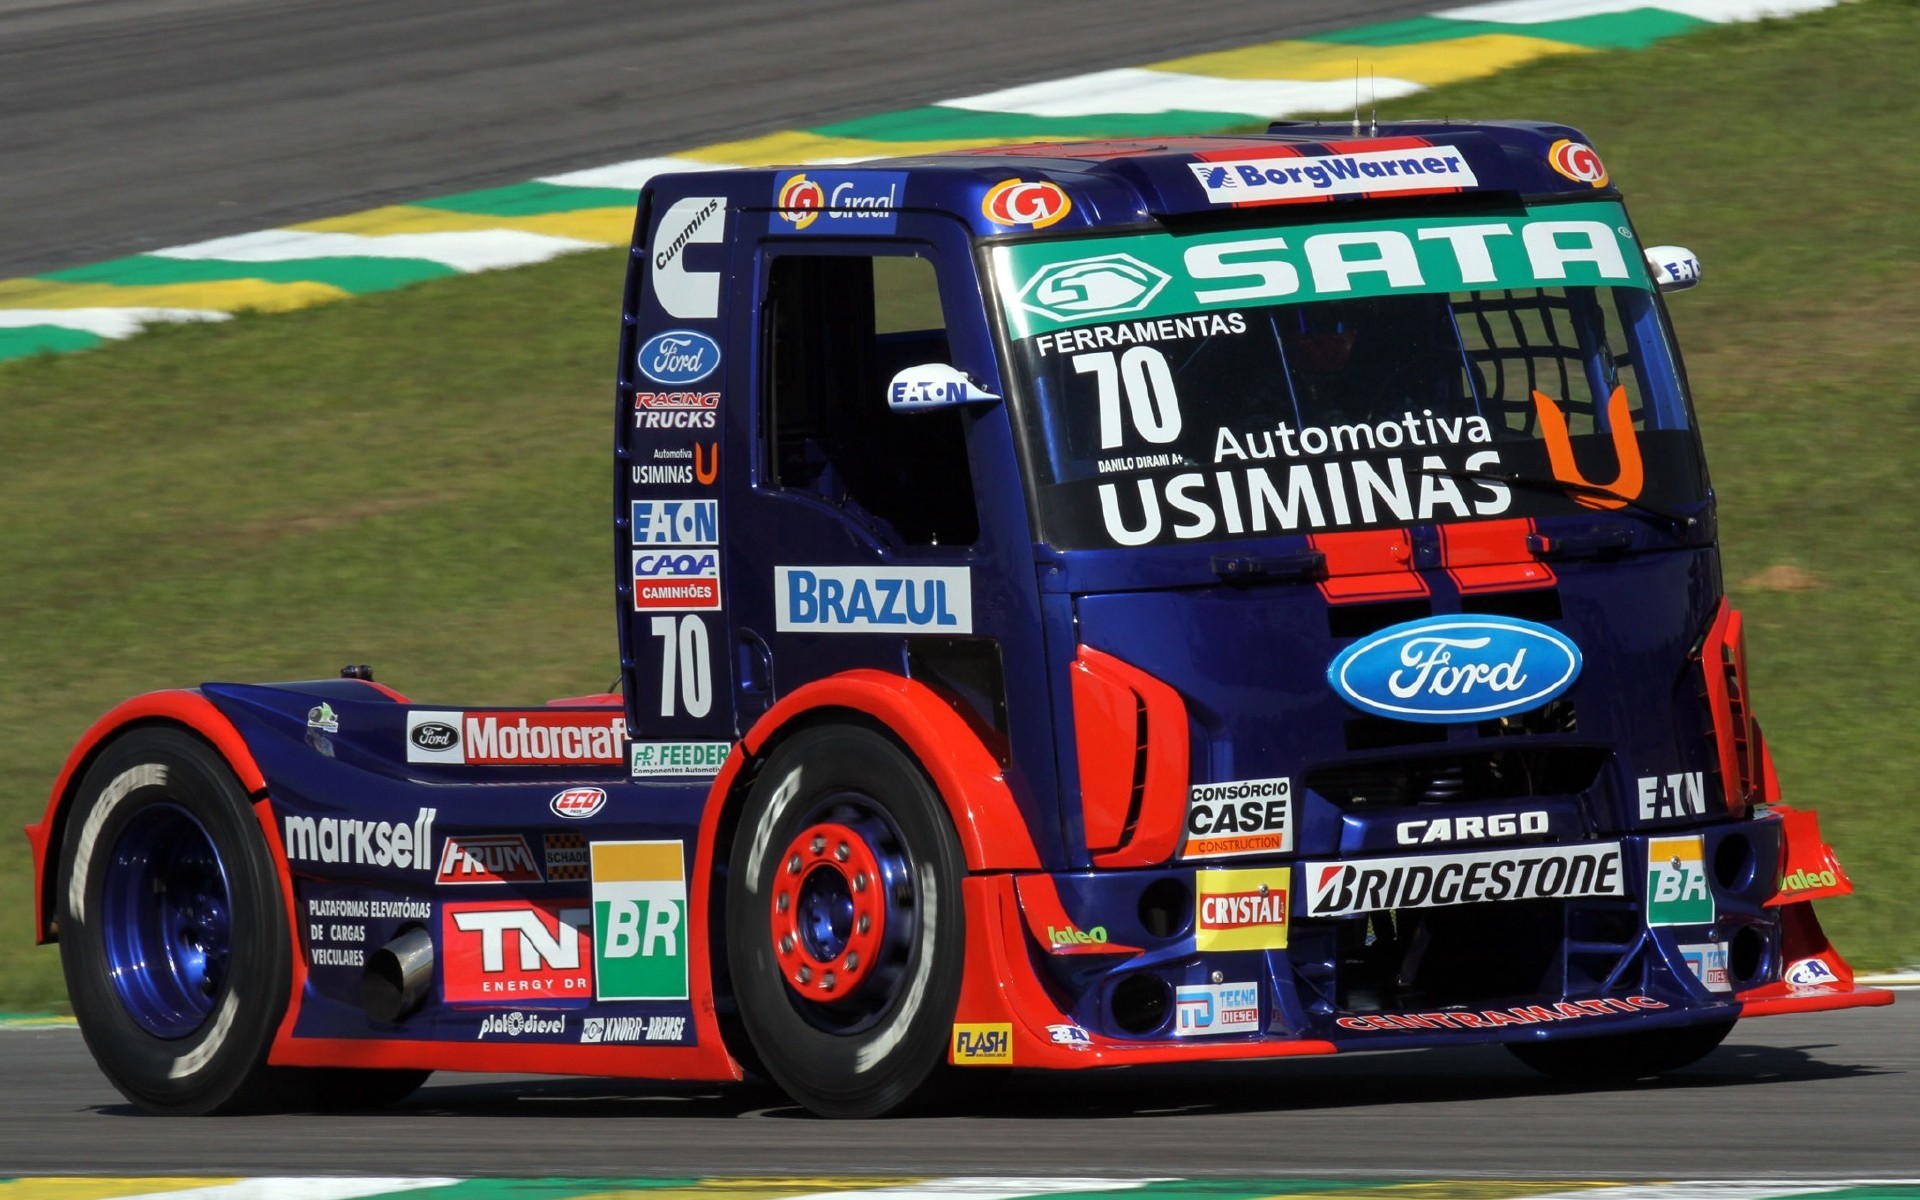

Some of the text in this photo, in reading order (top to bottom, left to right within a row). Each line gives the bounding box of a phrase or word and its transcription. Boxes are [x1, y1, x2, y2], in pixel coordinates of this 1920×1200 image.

[1234, 156, 1460, 189] BorgWarner
[828, 182, 897, 218] Graal
[656, 199, 718, 270] Cummins
[1184, 221, 1630, 304] SATA
[1036, 313, 1247, 357] FERRAMENTAS
[653, 337, 704, 373] Ford
[635, 392, 721, 409] RACING
[1073, 346, 1182, 450] 70
[635, 411, 716, 428] TRUCKS
[1213, 409, 1492, 463] Automotiva
[653, 448, 692, 460] Automotiva
[1098, 457, 1134, 473] DANILO
[1136, 454, 1170, 469] DIRANI
[632, 465, 693, 484] USIMINAS
[1098, 451, 1512, 546] USIMINAS
[633, 502, 716, 543] EATON
[642, 583, 712, 600] CAMINHÕES
[787, 570, 957, 626] BRAZUL
[651, 614, 712, 718] 70
[1388, 636, 1528, 699] Ford
[419, 717, 627, 759] Ford Motorcraf
[633, 767, 683, 775] Componentes
[558, 792, 601, 808] ECO
[1191, 782, 1288, 802] CONSÓRCIO
[1188, 800, 1287, 835] CASE
[1396, 811, 1549, 845] CARGO
[285, 807, 437, 870] marksell
[1198, 836, 1280, 853] CONSTRUCTION
[442, 842, 533, 874] FRUM
[1312, 852, 1618, 913] BRIDGESTONE
[1654, 867, 1707, 903] BR
[309, 896, 431, 919] PLATAFORMAS ELEVATÓRIAS
[1202, 896, 1283, 924] CRYSTAL
[310, 924, 365, 942] DE CARGAS
[604, 899, 680, 958] BR
[311, 949, 364, 967] VEICULARES
[483, 978, 587, 992] ENERGY DR
[1220, 989, 1255, 1007] TECNO
[603, 1017, 685, 1041] KNORR-BREMSE
[1222, 1009, 1257, 1023] DIESEL
[1337, 995, 1669, 1031] CENTRAMATIC
[956, 1031, 1008, 1057] FLASH
